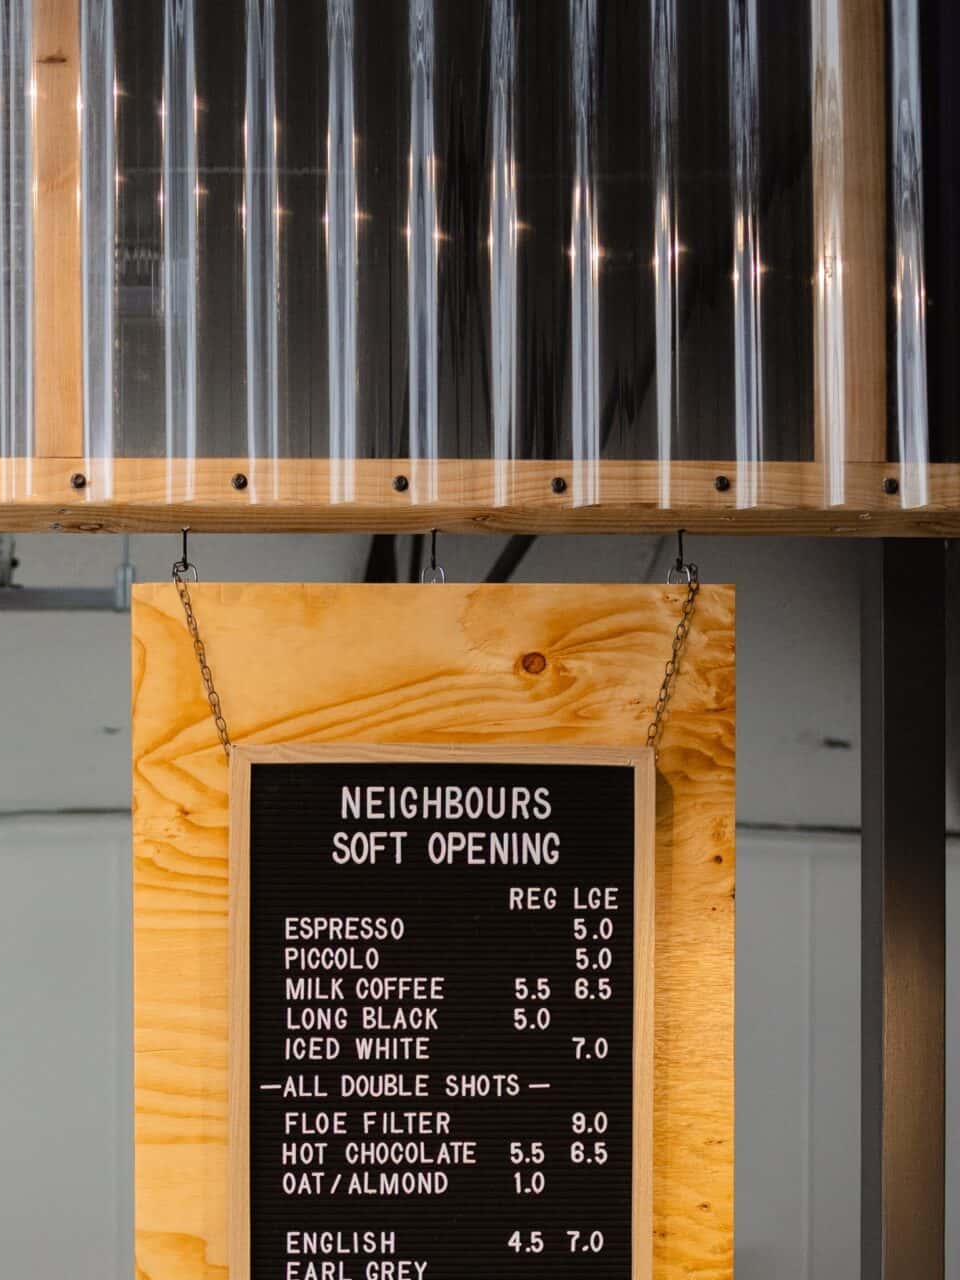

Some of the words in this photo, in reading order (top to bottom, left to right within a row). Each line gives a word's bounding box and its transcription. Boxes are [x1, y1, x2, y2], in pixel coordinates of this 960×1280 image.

[341, 785, 552, 820] NEIGHBOURS
[332, 831, 408, 865] SOFT
[427, 831, 561, 866] OPENING
[509, 887, 557, 911] REG
[573, 887, 619, 910] LGE
[285, 917, 405, 941] ESPRESSO
[573, 918, 614, 941] 5.0
[284, 947, 380, 971] PICCOLO
[575, 948, 612, 970] 5.0
[285, 976, 345, 1001] MILK
[355, 976, 445, 1001] COFFEE
[515, 977, 551, 1001] 5.5
[574, 977, 612, 1001] 6.5
[286, 1007, 348, 1031] LONG
[362, 1006, 439, 1030] BLACK
[513, 1007, 551, 1031] 5.0
[285, 1036, 340, 1061] ICED
[355, 1036, 430, 1060] WHITE
[571, 1036, 609, 1060] 7.0
[341, 1073, 430, 1098] DOUBLE
[285, 1111, 348, 1135] FLOE
[363, 1111, 451, 1135] FILTER
[571, 1111, 608, 1134] 9.0
[282, 1142, 329, 1165] HOT
[345, 1141, 477, 1165] CHOCOLATE
[510, 1141, 545, 1165] 5.5
[570, 1141, 608, 1165] 6.5
[282, 1171, 449, 1195] OAT/ALMOND
[513, 1171, 545, 1194] 1.0
[286, 1231, 396, 1255] ENGLISH
[507, 1230, 545, 1254] 4.5
[566, 1230, 604, 1253] 7.0
